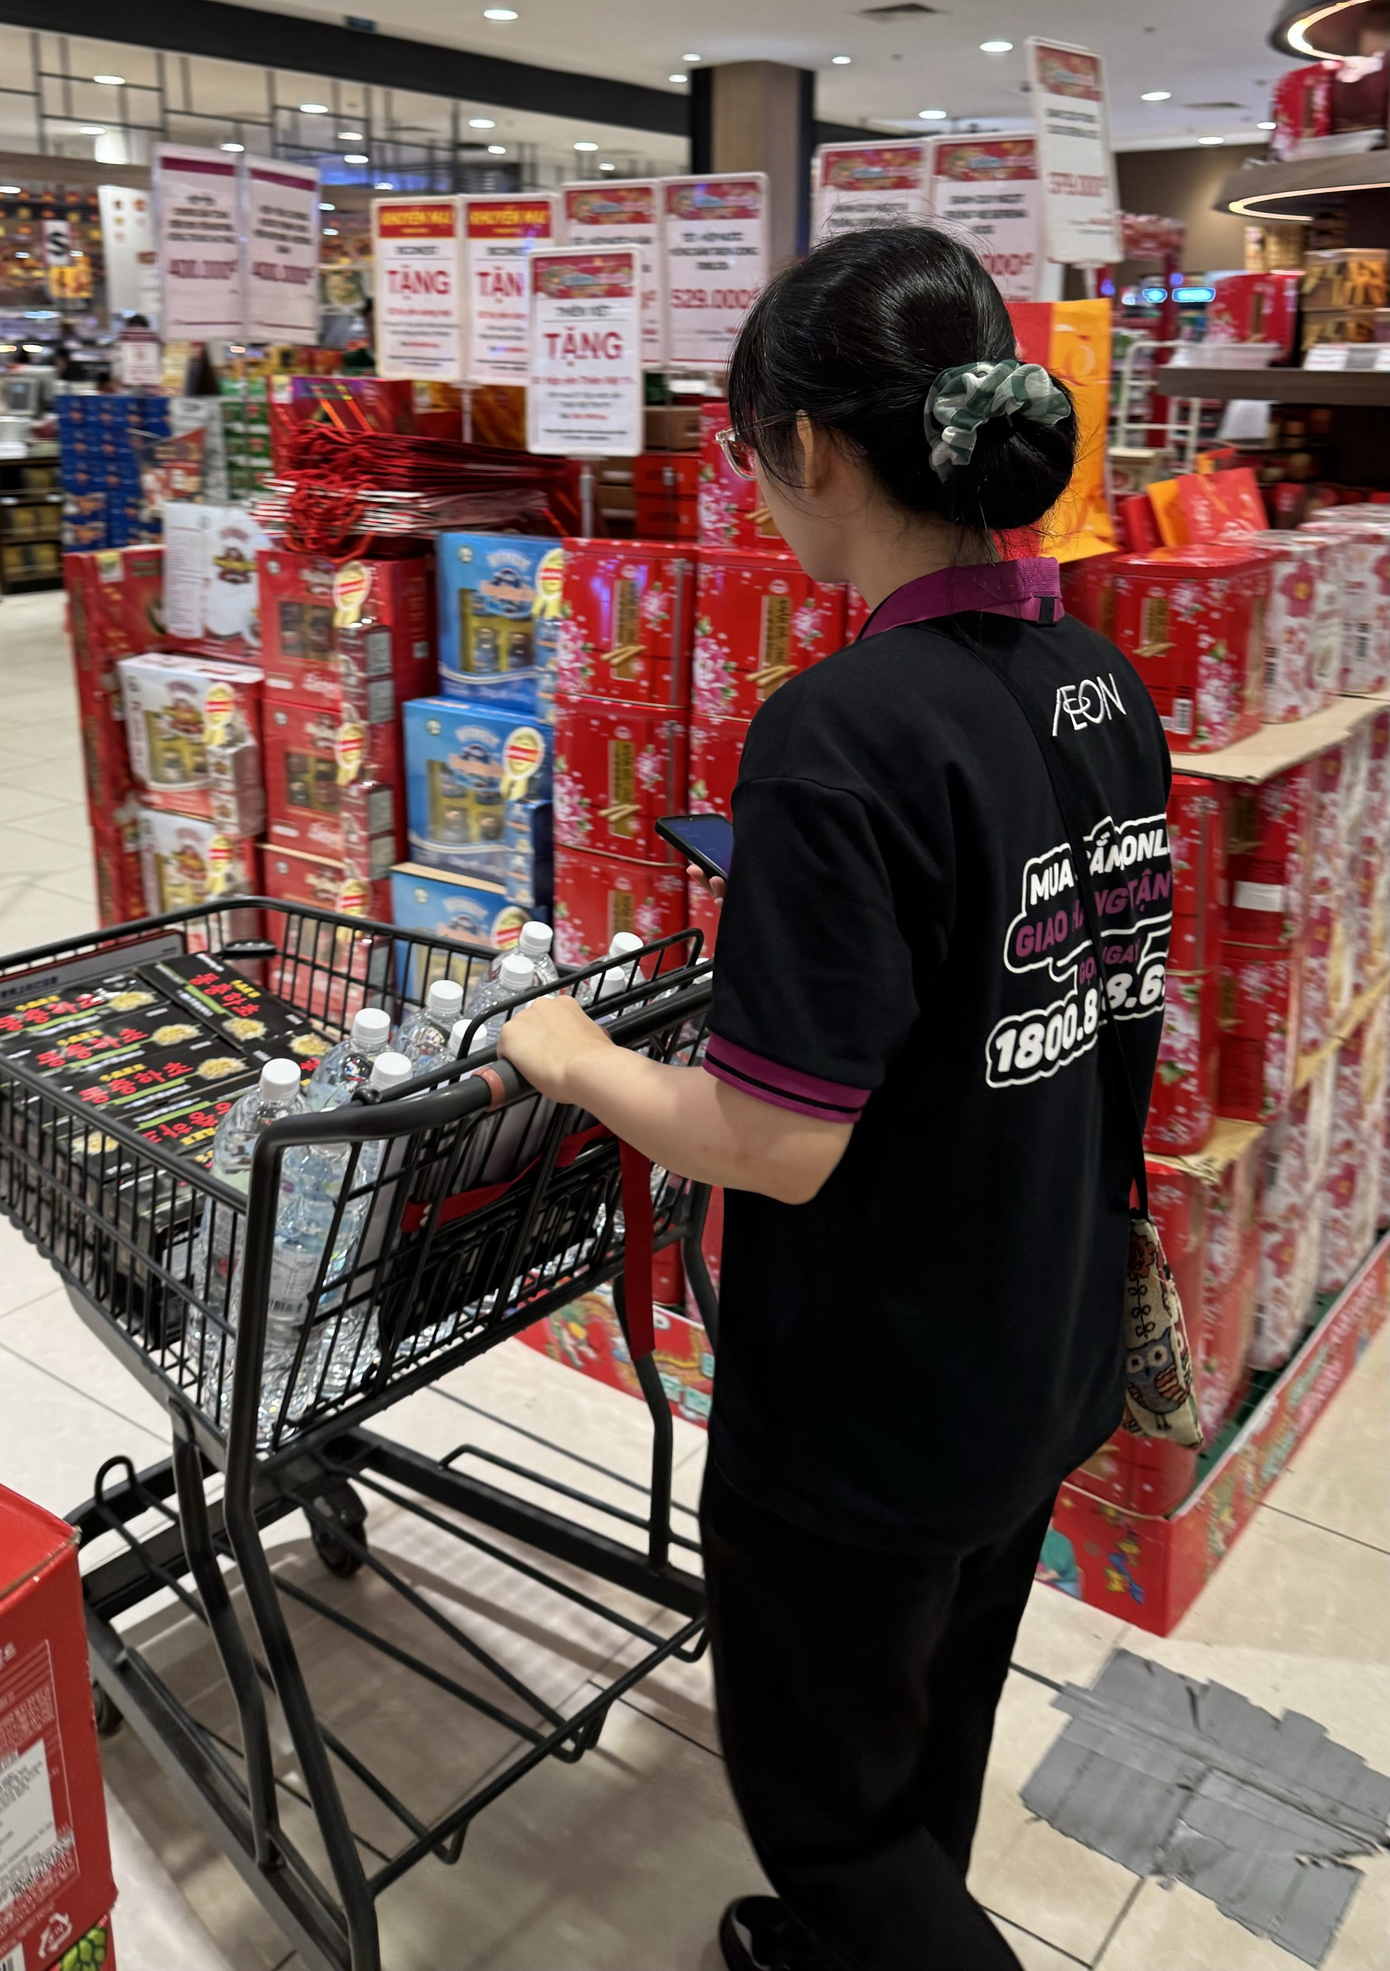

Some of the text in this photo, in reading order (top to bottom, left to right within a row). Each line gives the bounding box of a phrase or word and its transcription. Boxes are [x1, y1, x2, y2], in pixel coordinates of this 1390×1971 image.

[386, 264, 452, 300] TẶNG
[476, 266, 525, 303] TẶN
[543, 325, 624, 367] TẶNG
[1030, 828, 1170, 905] MUA ẮM ONL
[1015, 910, 1068, 958] GIAO
[1078, 955, 1098, 986] GỌ
[190, 973, 261, 1018] 동충하초
[35, 1027, 149, 1068] 동충하초
[78, 1061, 194, 1104] 동충하초
